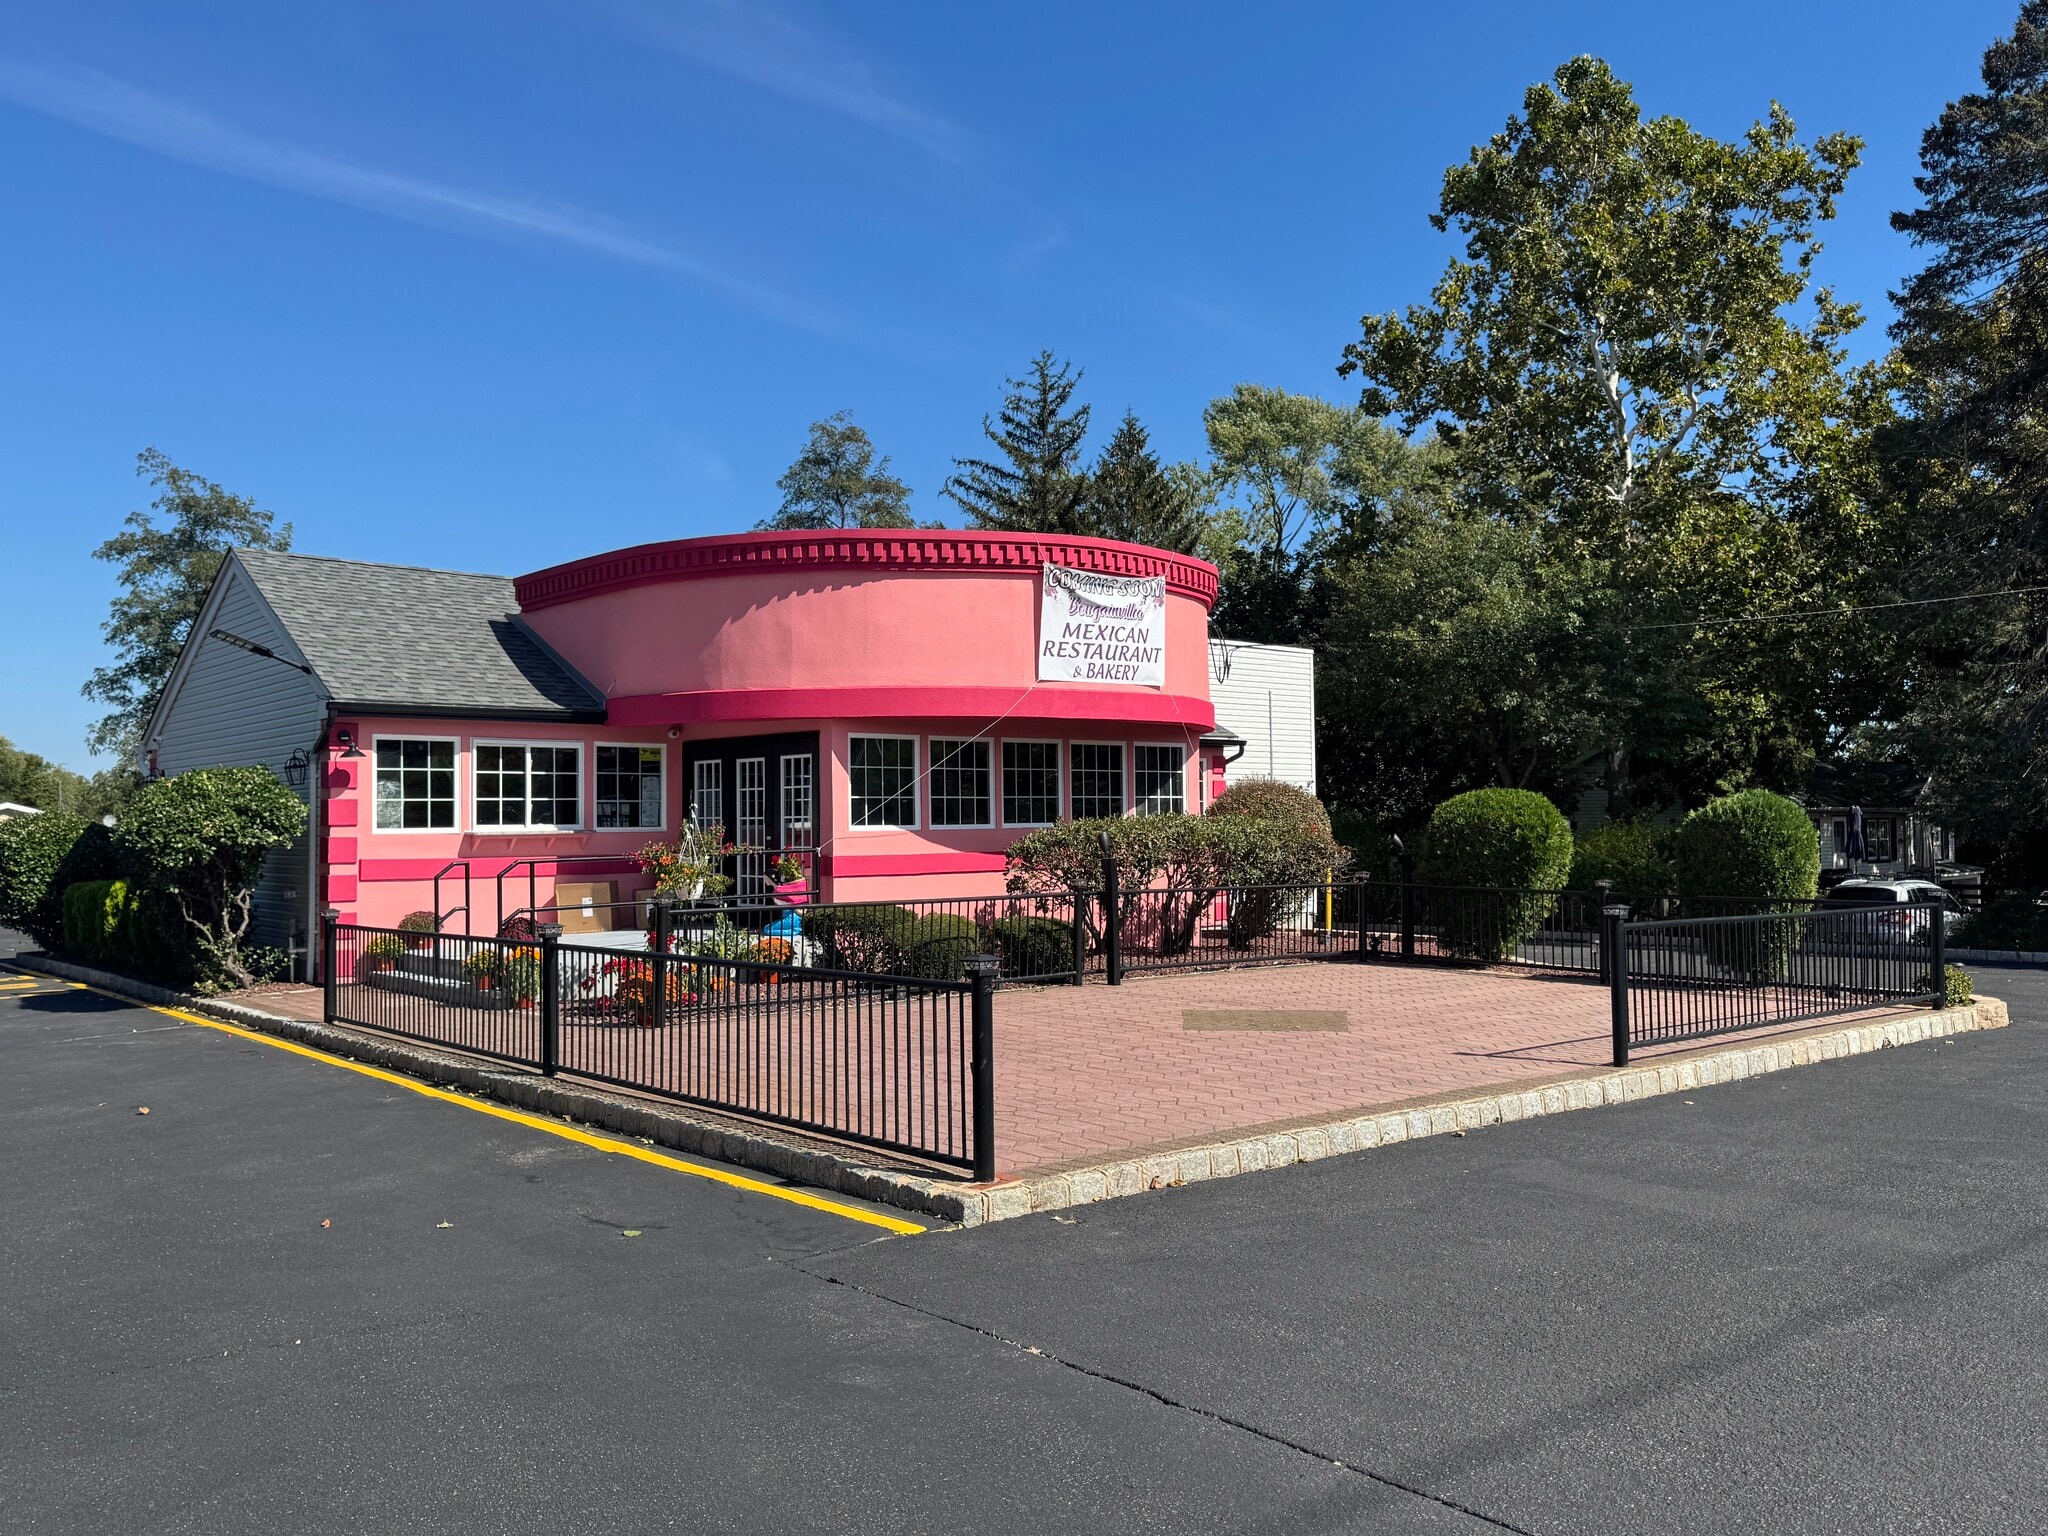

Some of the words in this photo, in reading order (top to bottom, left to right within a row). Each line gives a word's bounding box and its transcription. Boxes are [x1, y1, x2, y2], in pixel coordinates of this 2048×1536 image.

[1048, 568, 1116, 596] COMING
[1118, 577, 1161, 598] SOON
[1062, 622, 1149, 644] MEXICAN
[1043, 640, 1162, 663] RESTAURANT
[1073, 665, 1082, 678] &
[1086, 662, 1139, 681] BAKERY
